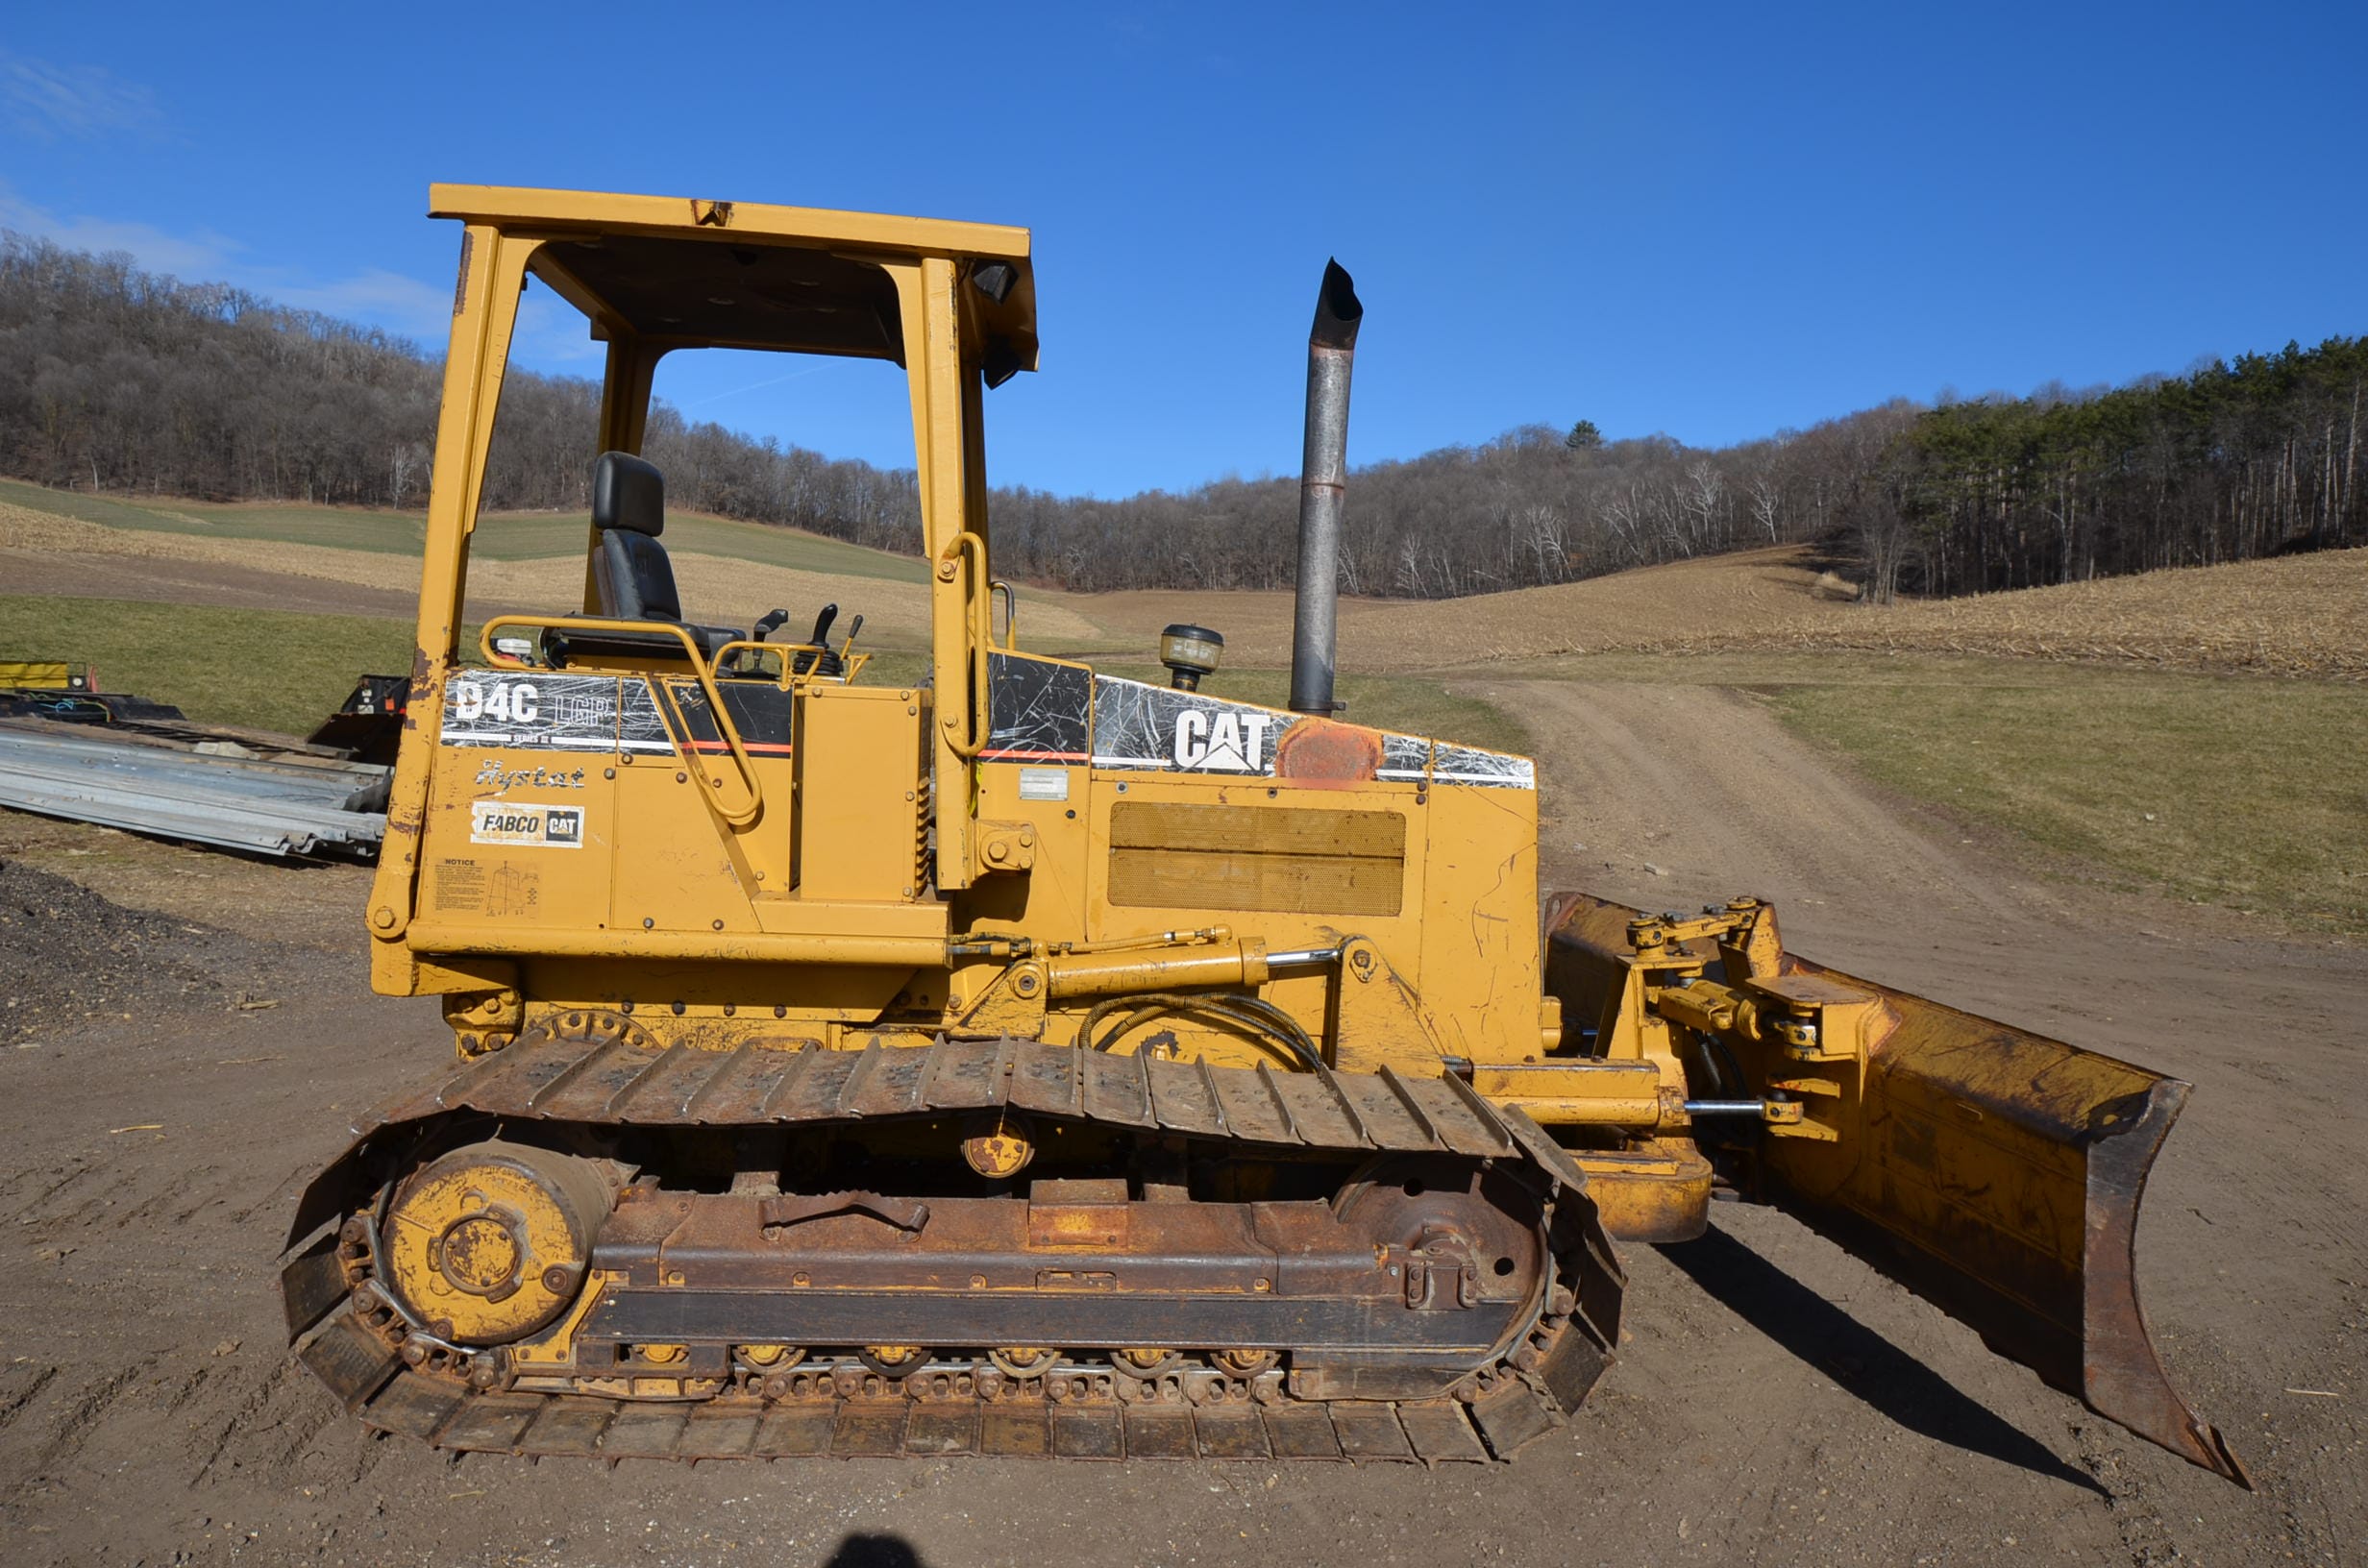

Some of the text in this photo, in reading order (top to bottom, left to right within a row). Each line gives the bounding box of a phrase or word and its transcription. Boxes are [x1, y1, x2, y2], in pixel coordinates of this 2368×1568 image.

[456, 680, 609, 726] D4C LGP
[1174, 710, 1270, 771] CAT
[482, 814, 577, 834] FABCO CAT
